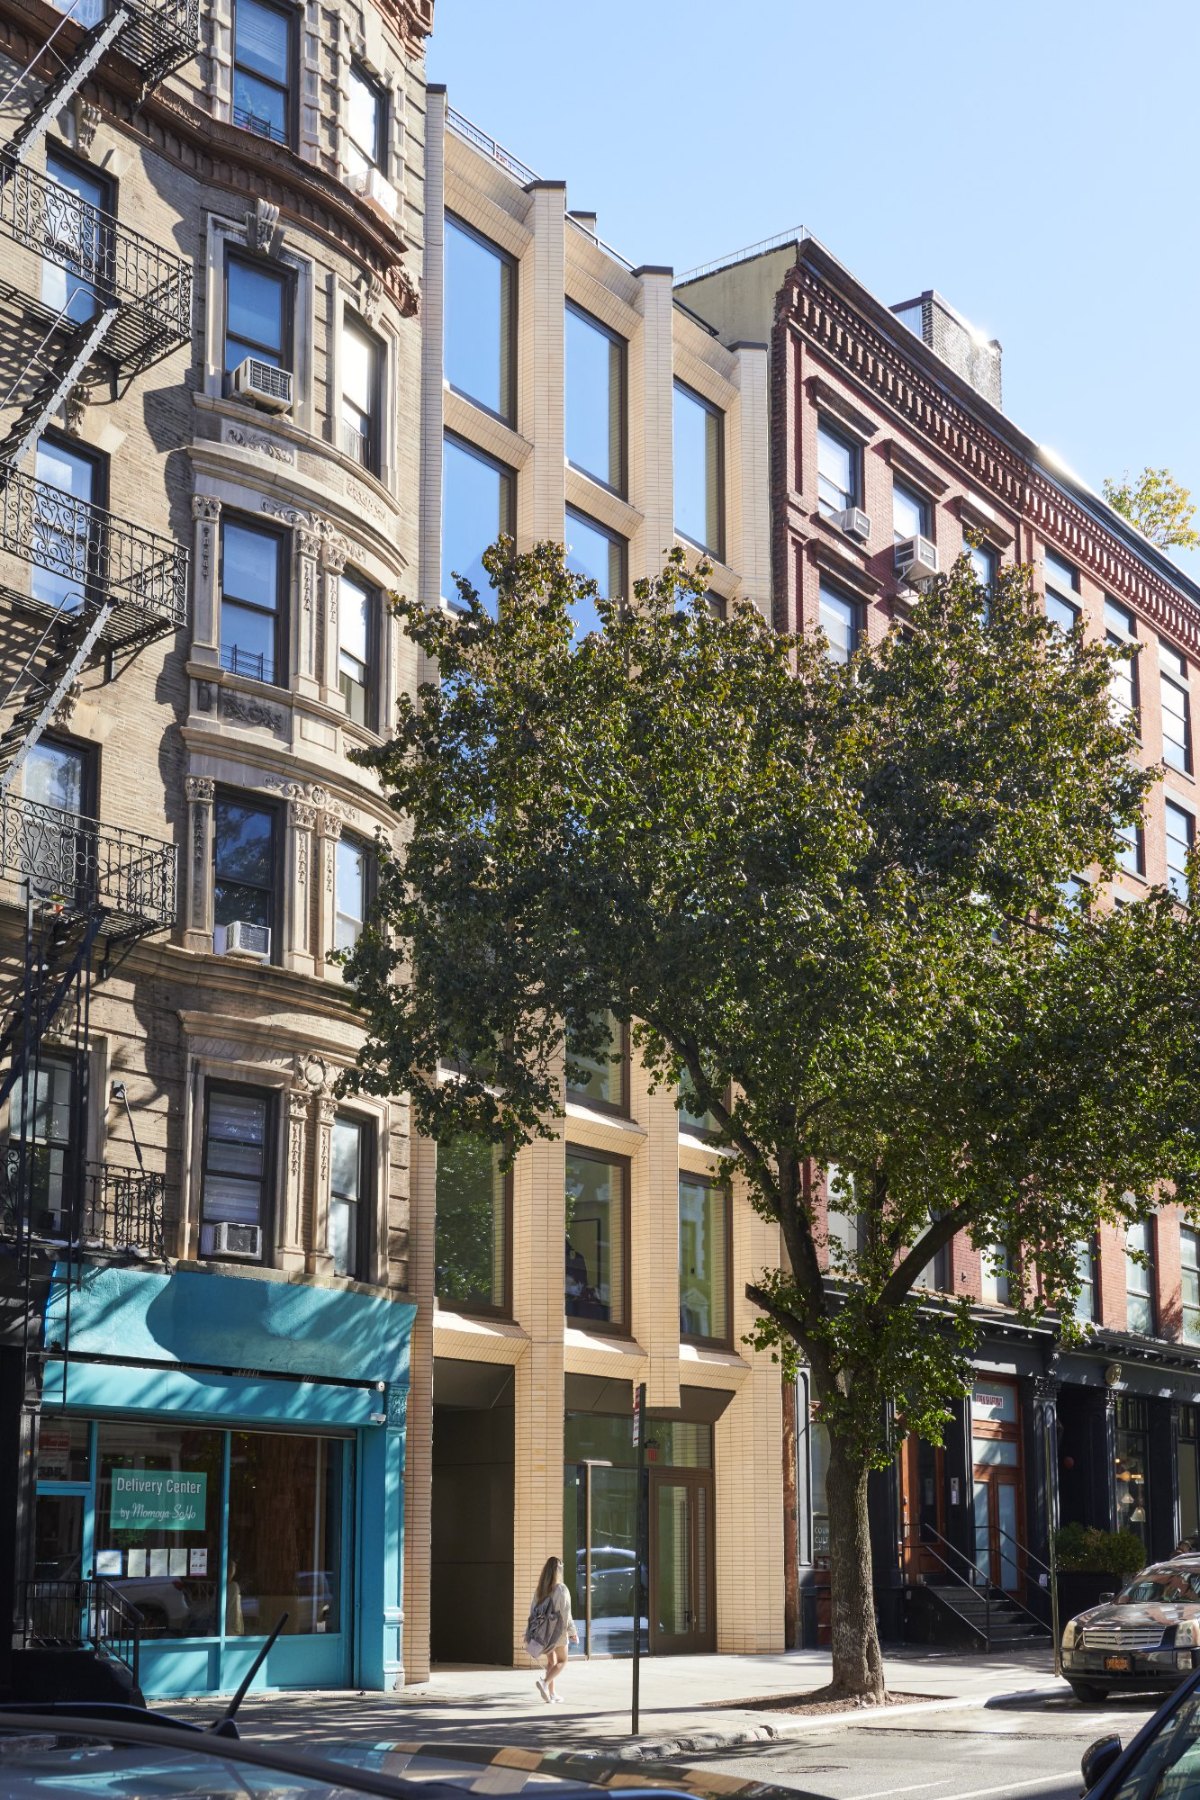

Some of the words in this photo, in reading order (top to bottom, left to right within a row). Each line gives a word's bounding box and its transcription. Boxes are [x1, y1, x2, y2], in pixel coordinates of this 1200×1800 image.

[117, 1478, 162, 1495] Delivery
[166, 1480, 201, 1494] Center
[120, 1507, 130, 1520] by
[132, 1502, 170, 1522] Momoya
